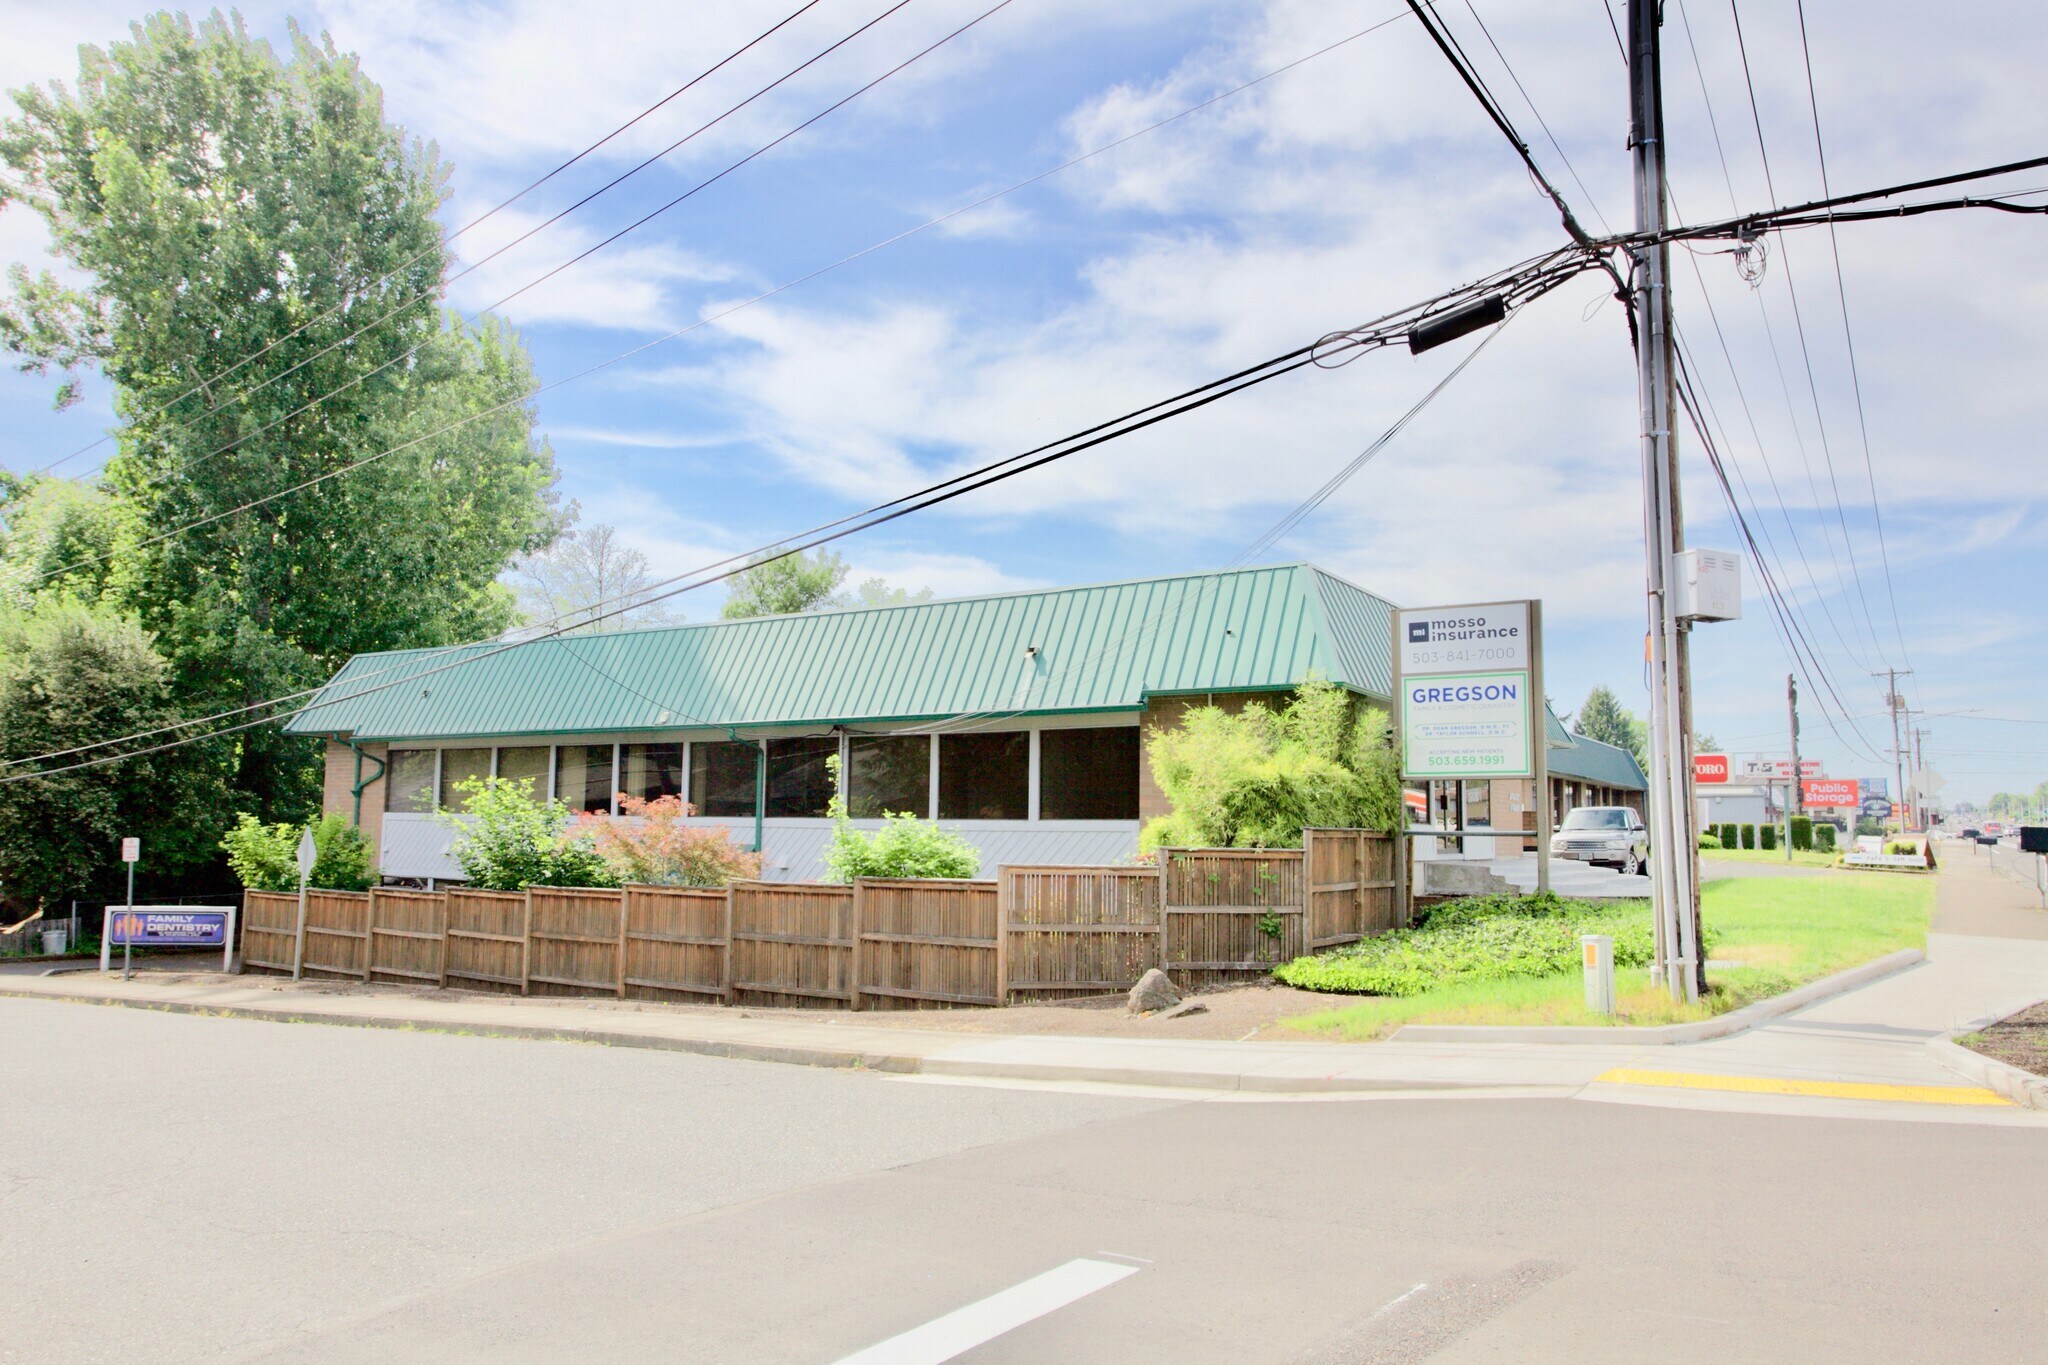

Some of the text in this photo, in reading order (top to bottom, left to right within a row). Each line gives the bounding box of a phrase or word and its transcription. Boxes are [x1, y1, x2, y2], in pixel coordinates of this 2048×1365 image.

[1432, 617, 1486, 630] mosso
[1432, 627, 1518, 642] insurance
[1413, 647, 1515, 664] 503-841-7000
[1413, 684, 1516, 703] GREGSON
[1429, 755, 1504, 766] 503.659.1991
[1695, 764, 1725, 774] ORO
[1810, 783, 1849, 793] Public
[1805, 792, 1854, 804] Storage
[147, 915, 195, 923] FAMILY
[147, 923, 220, 931] DENTISTRY
